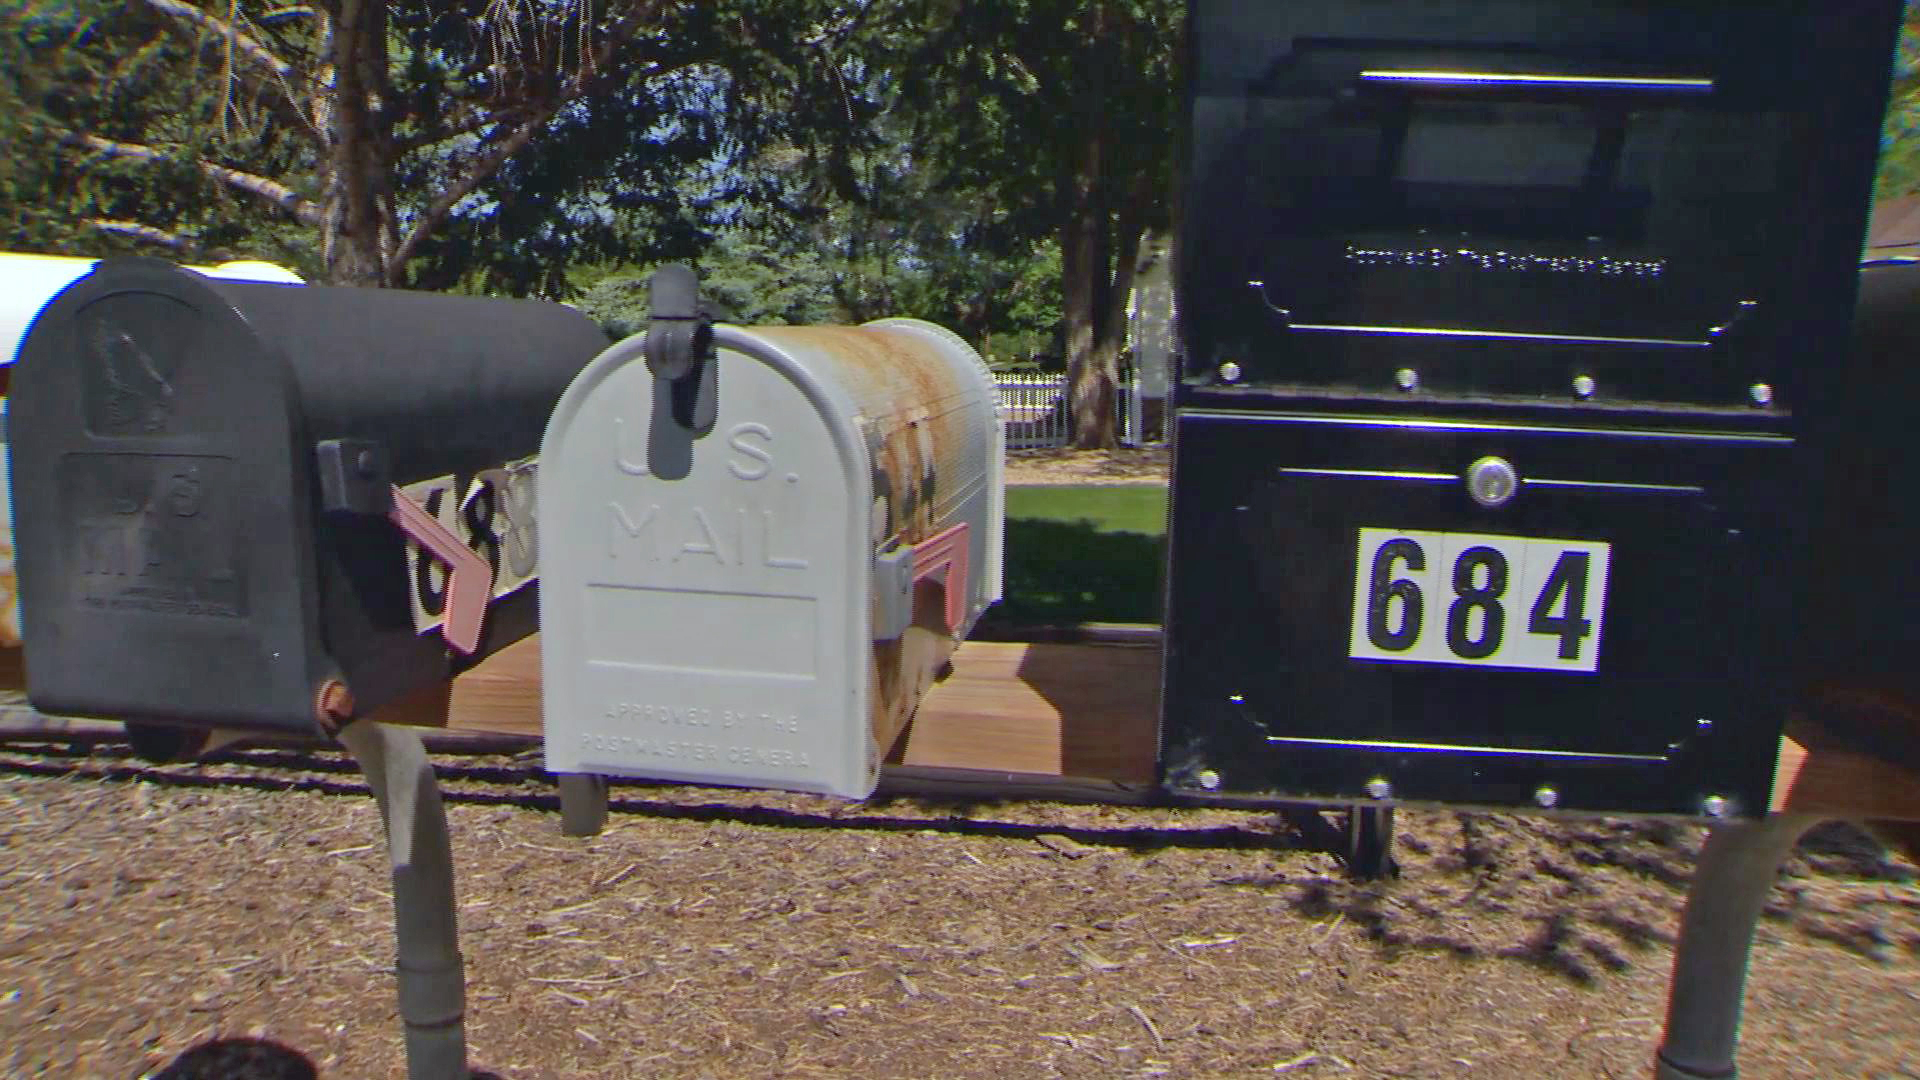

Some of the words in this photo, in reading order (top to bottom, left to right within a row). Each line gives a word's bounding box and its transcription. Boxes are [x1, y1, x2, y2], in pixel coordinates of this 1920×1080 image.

[608, 500, 810, 570] MAIL
[1366, 538, 1592, 660] 684
[605, 702, 711, 728] APPROVED
[723, 709, 746, 728] BY
[760, 712, 798, 734] THE
[581, 732, 717, 762] POSTMASTER
[727, 746, 812, 768] GENERA
